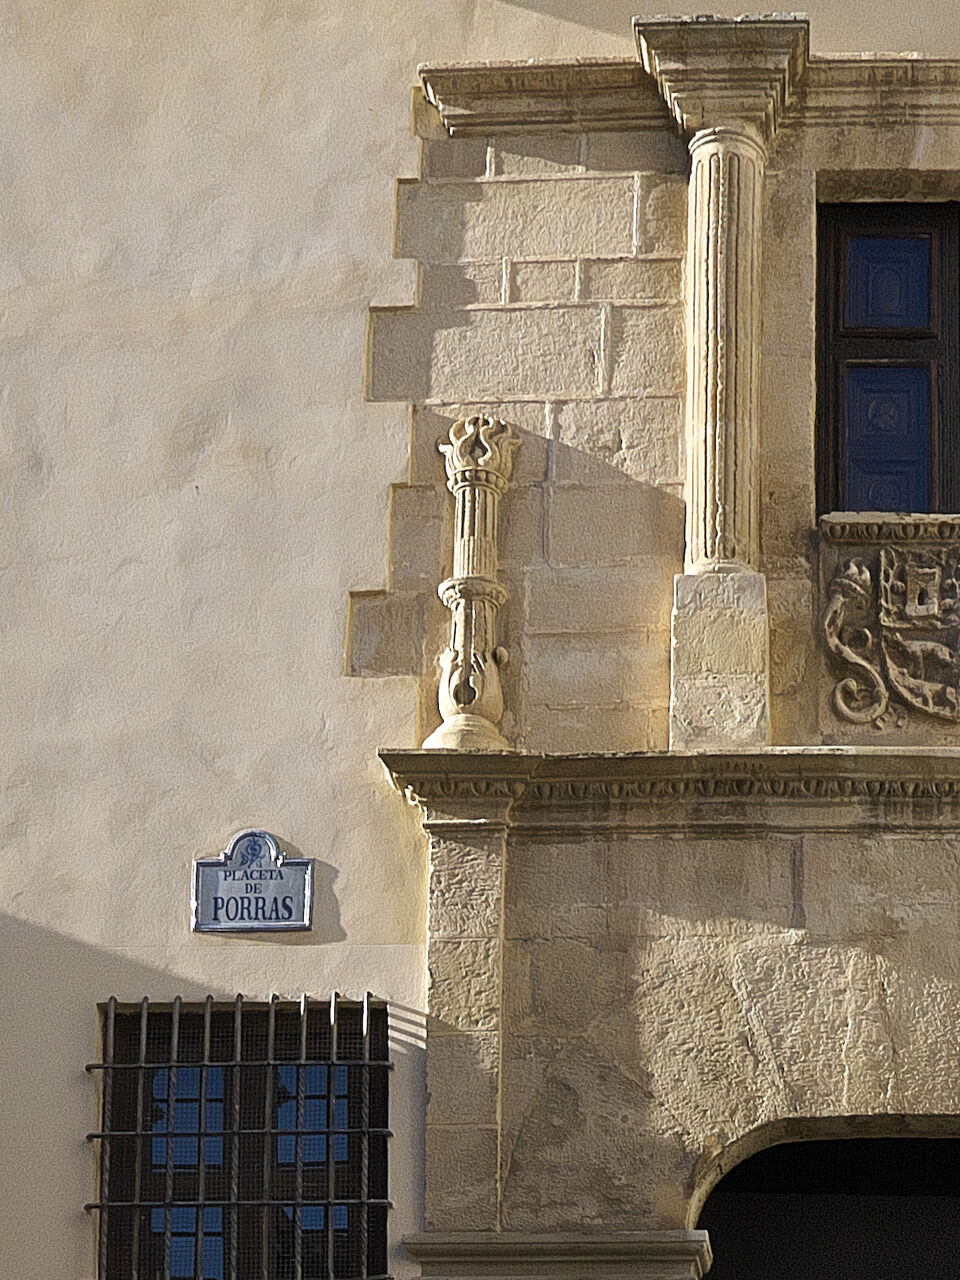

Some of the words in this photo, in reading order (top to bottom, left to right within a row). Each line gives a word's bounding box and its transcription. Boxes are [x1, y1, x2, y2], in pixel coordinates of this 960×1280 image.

[223, 869, 284, 881] PLACETA
[245, 883, 262, 894] DE
[212, 896, 294, 921] PORRAS
